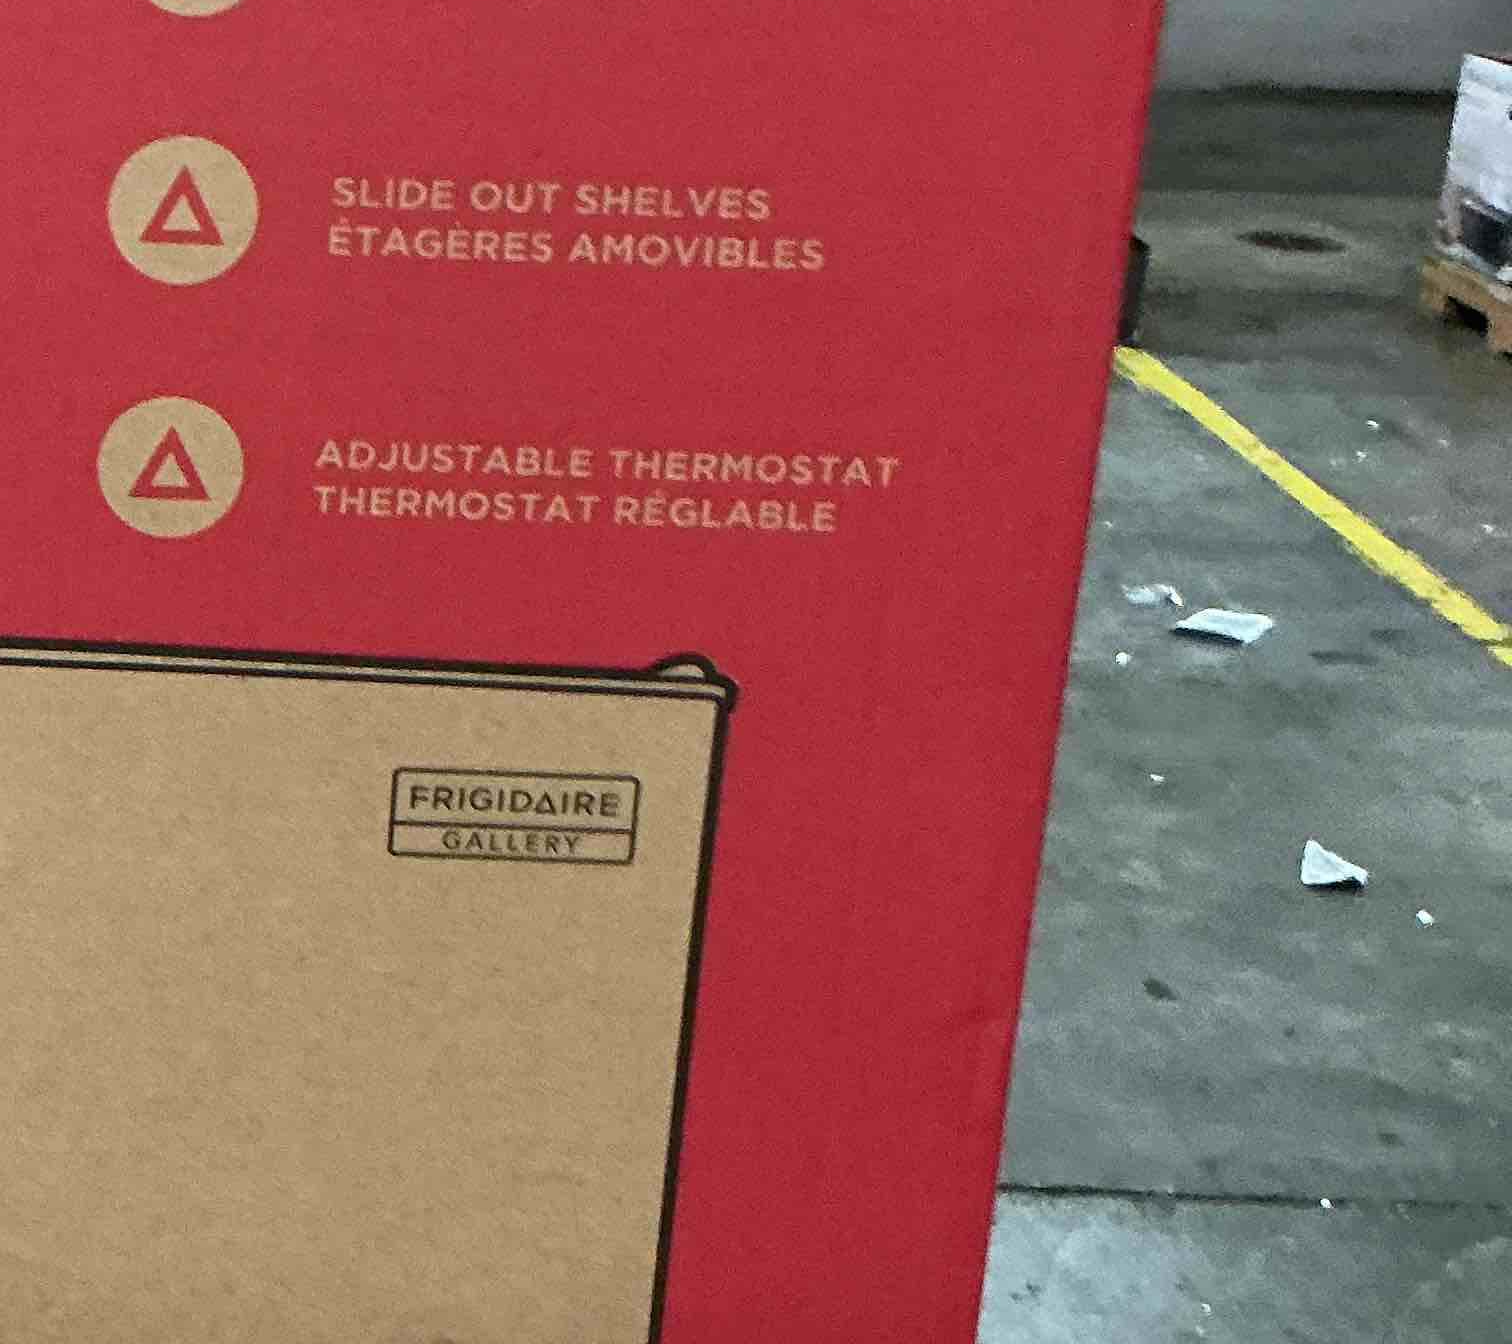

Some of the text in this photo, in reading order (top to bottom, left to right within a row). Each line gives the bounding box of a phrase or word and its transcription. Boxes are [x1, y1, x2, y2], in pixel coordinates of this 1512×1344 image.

[333, 177, 770, 221] SLIDE OUT SHELVES
[568, 232, 824, 270] AMOVIBLES
[315, 439, 899, 487] ADJUSTABLE THERMOSTAT
[313, 485, 836, 532] THERMOSTAT RÉGLABLE
[409, 785, 620, 816] FRIGIDAIRE
[442, 830, 581, 853] GALLERY
